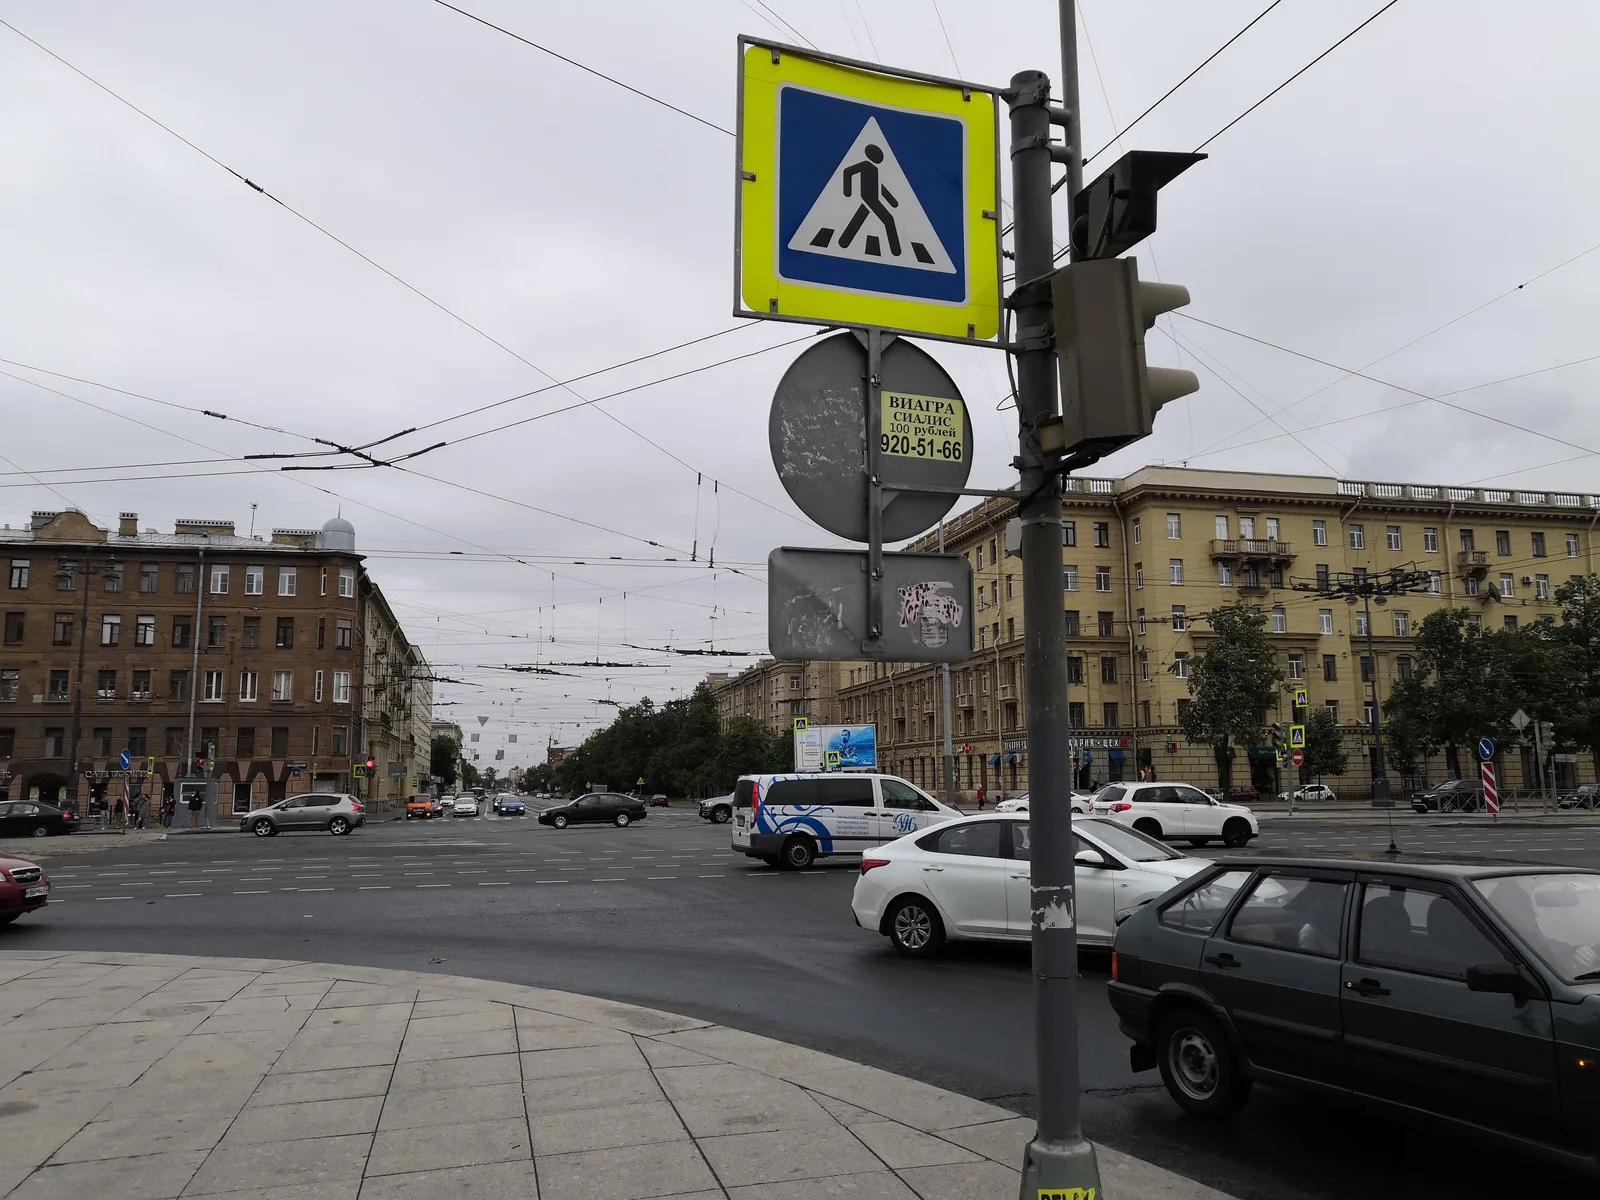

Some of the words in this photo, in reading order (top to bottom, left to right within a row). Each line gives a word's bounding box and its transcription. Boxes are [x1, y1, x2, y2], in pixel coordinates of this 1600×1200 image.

[888, 396, 956, 415] ВИАГРА
[893, 411, 952, 427] СИАЛИС
[889, 423, 910, 433] 100
[914, 426, 957, 437] рублей
[881, 434, 962, 460] 920-51-66
[1103, 738, 1119, 748] ЦЕХ
